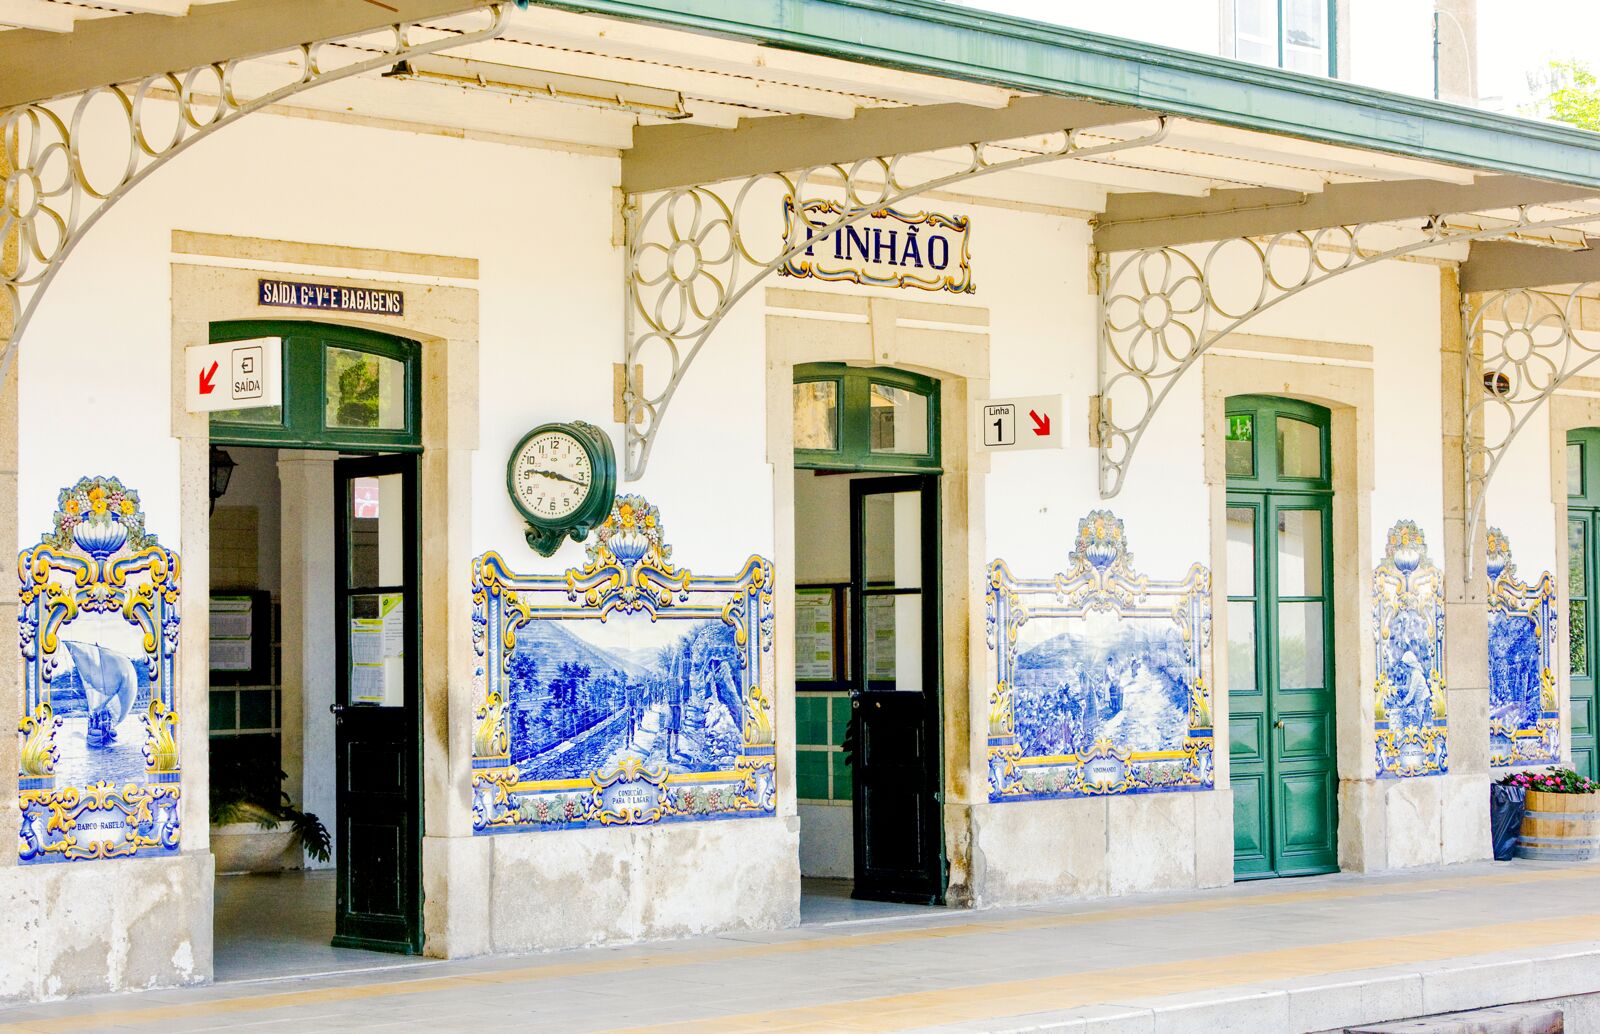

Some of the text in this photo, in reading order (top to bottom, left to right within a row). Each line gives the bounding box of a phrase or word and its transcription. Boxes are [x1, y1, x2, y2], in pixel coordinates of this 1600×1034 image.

[804, 220, 949, 271] PINHÃO
[263, 281, 297, 305] SAÍDA
[330, 288, 339, 308] E
[341, 289, 400, 313] BAGAGENS
[234, 377, 261, 393] SAÍDA
[989, 407, 1010, 416] Linha
[993, 418, 1002, 442] 1
[538, 445, 545, 454] 11
[550, 440, 560, 450] 12
[567, 445, 571, 454] 1
[526, 455, 535, 465] 10
[575, 456, 583, 466] 2
[523, 470, 531, 480] 9
[577, 471, 585, 481] 3
[526, 485, 533, 495] 8
[572, 487, 580, 496] 4
[536, 497, 543, 506] 7
[549, 501, 556, 511] 6
[563, 497, 570, 507] 5
[77, 821, 125, 831] BARCO RABELO
